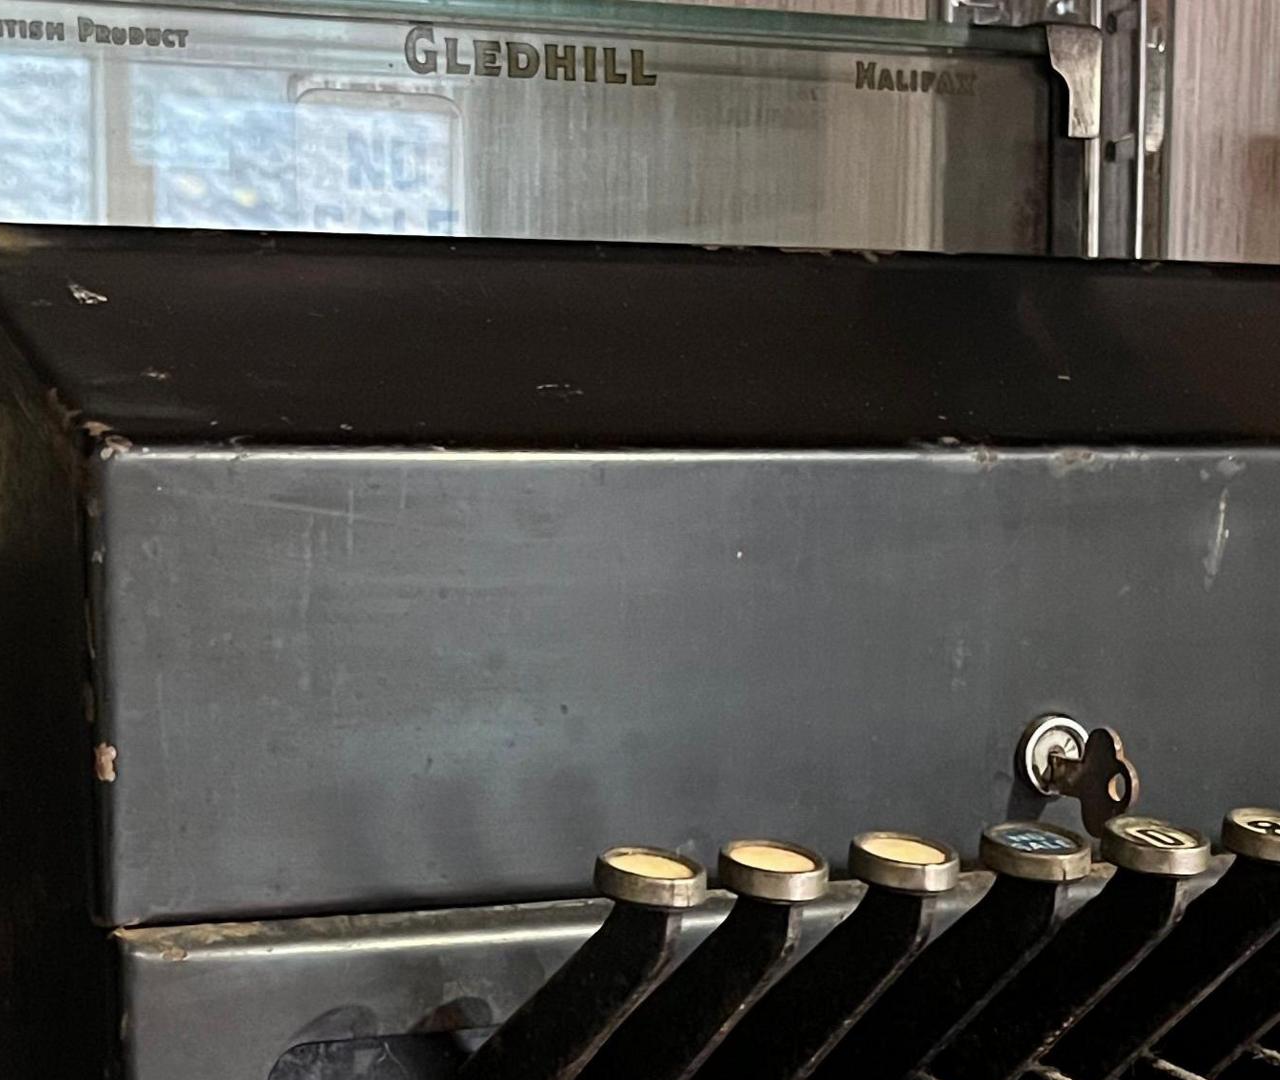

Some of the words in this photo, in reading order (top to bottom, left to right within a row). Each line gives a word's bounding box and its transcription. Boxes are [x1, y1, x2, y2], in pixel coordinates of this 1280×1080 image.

[78, 16, 189, 47] PRODUCT
[404, 25, 657, 86] GLEDHILL
[855, 60, 978, 96] HALIFAX
